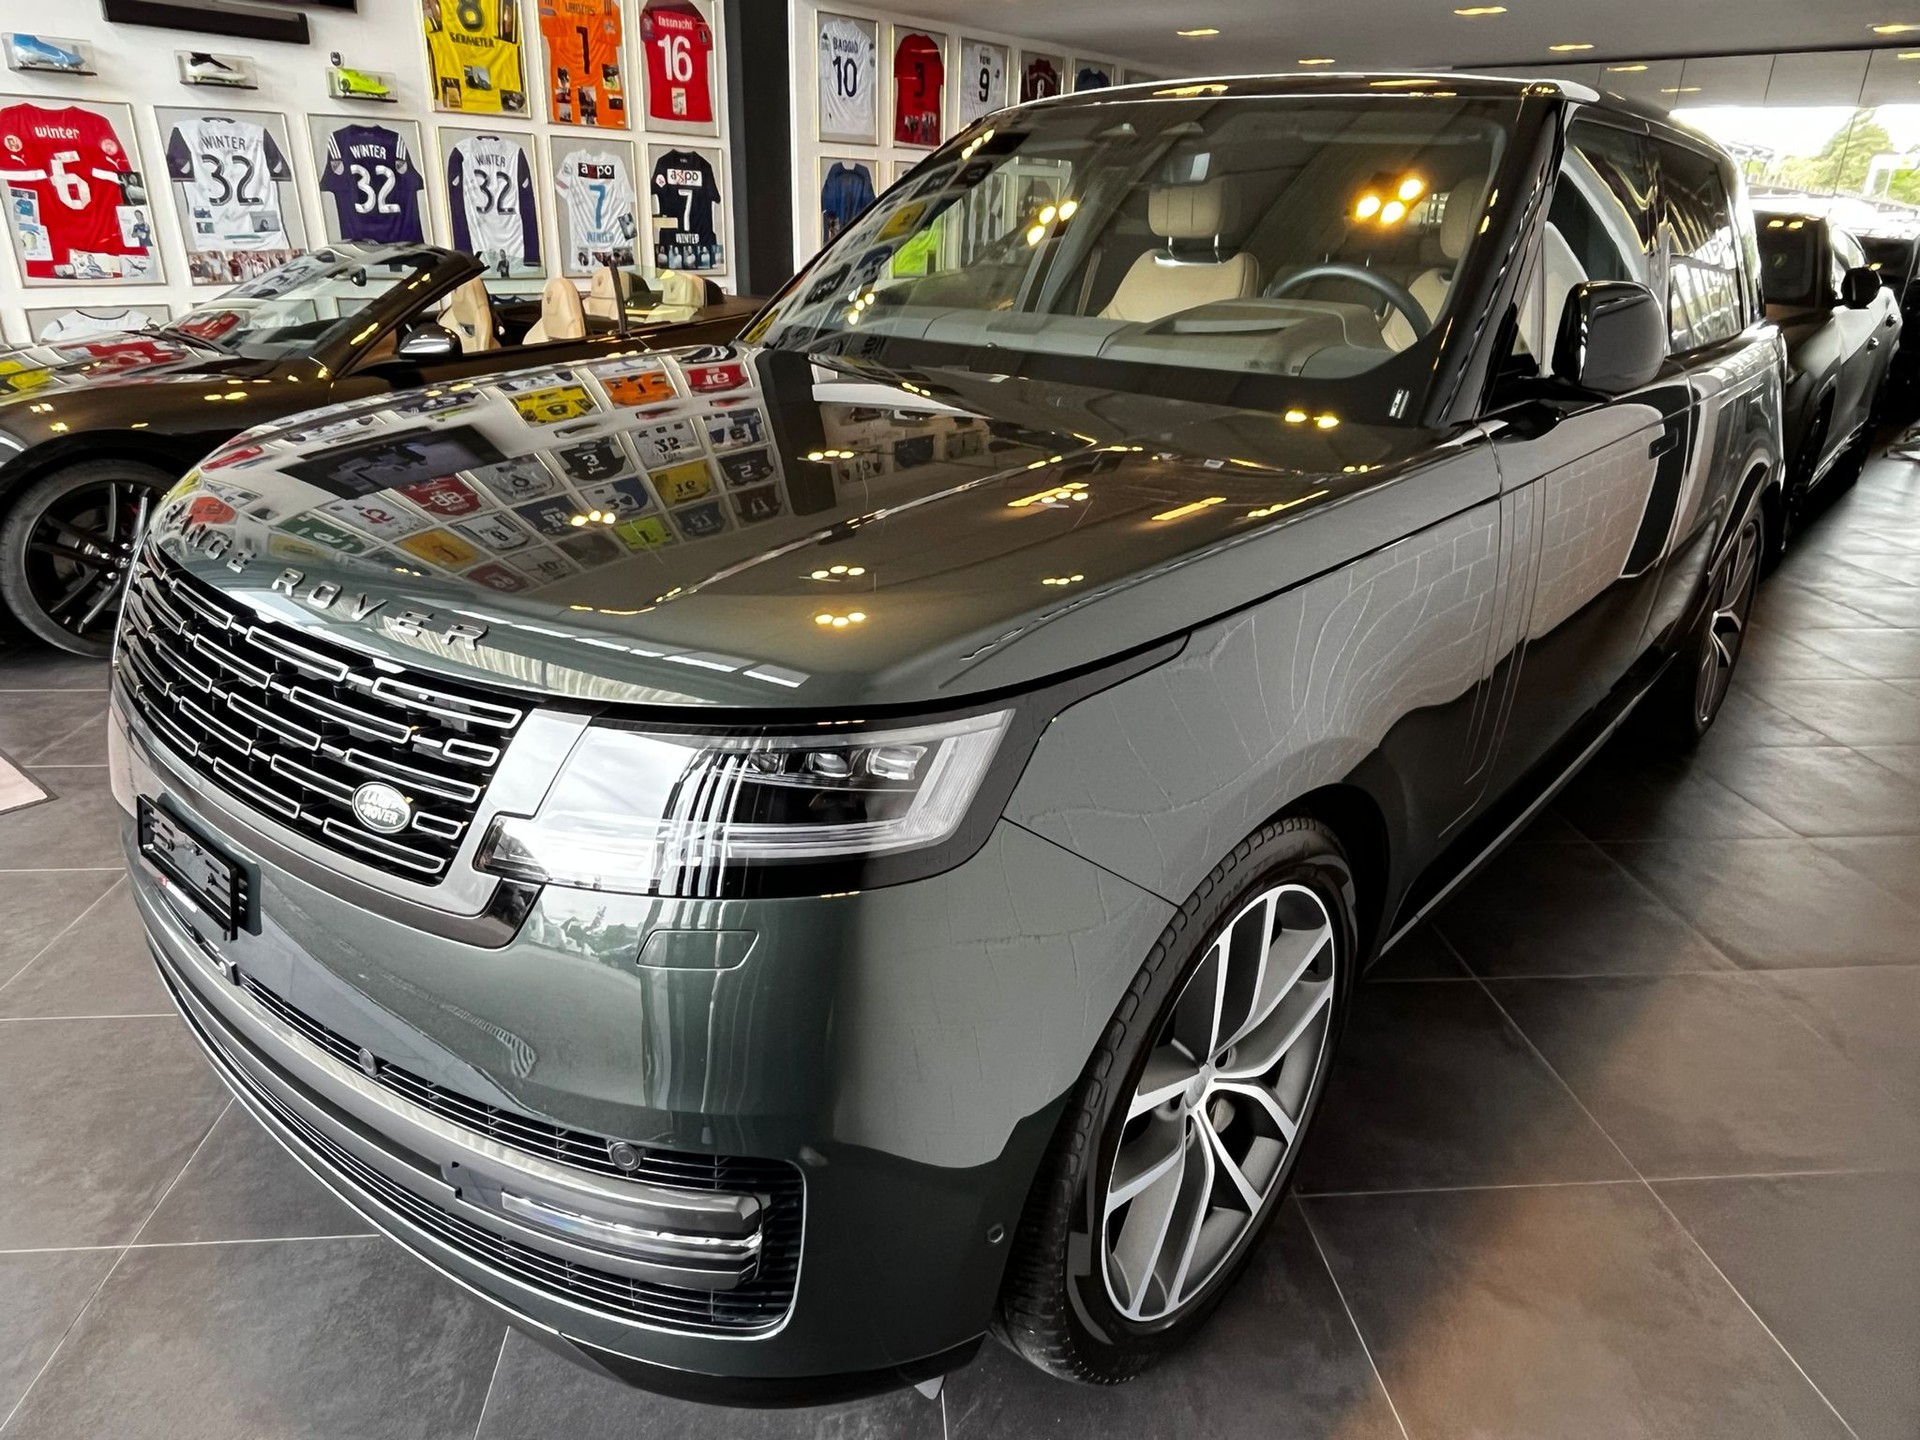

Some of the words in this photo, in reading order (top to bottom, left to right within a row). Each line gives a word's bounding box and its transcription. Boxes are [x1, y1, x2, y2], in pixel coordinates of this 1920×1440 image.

[576, 26, 590, 74] 1
[657, 34, 693, 82] 16
[832, 56, 857, 97] 10
[979, 67, 990, 102] 9
[34, 125, 80, 140] winter
[201, 135, 247, 151] WINTER
[349, 144, 387, 160] WINTER
[50, 150, 92, 211] 6
[201, 153, 264, 207] 32
[475, 153, 506, 168] WINTER
[580, 163, 613, 179] apo
[350, 164, 402, 214] 32
[474, 169, 517, 216] 32
[588, 184, 606, 230] 7
[678, 189, 693, 232] 7
[271, 567, 489, 651] ROVER
